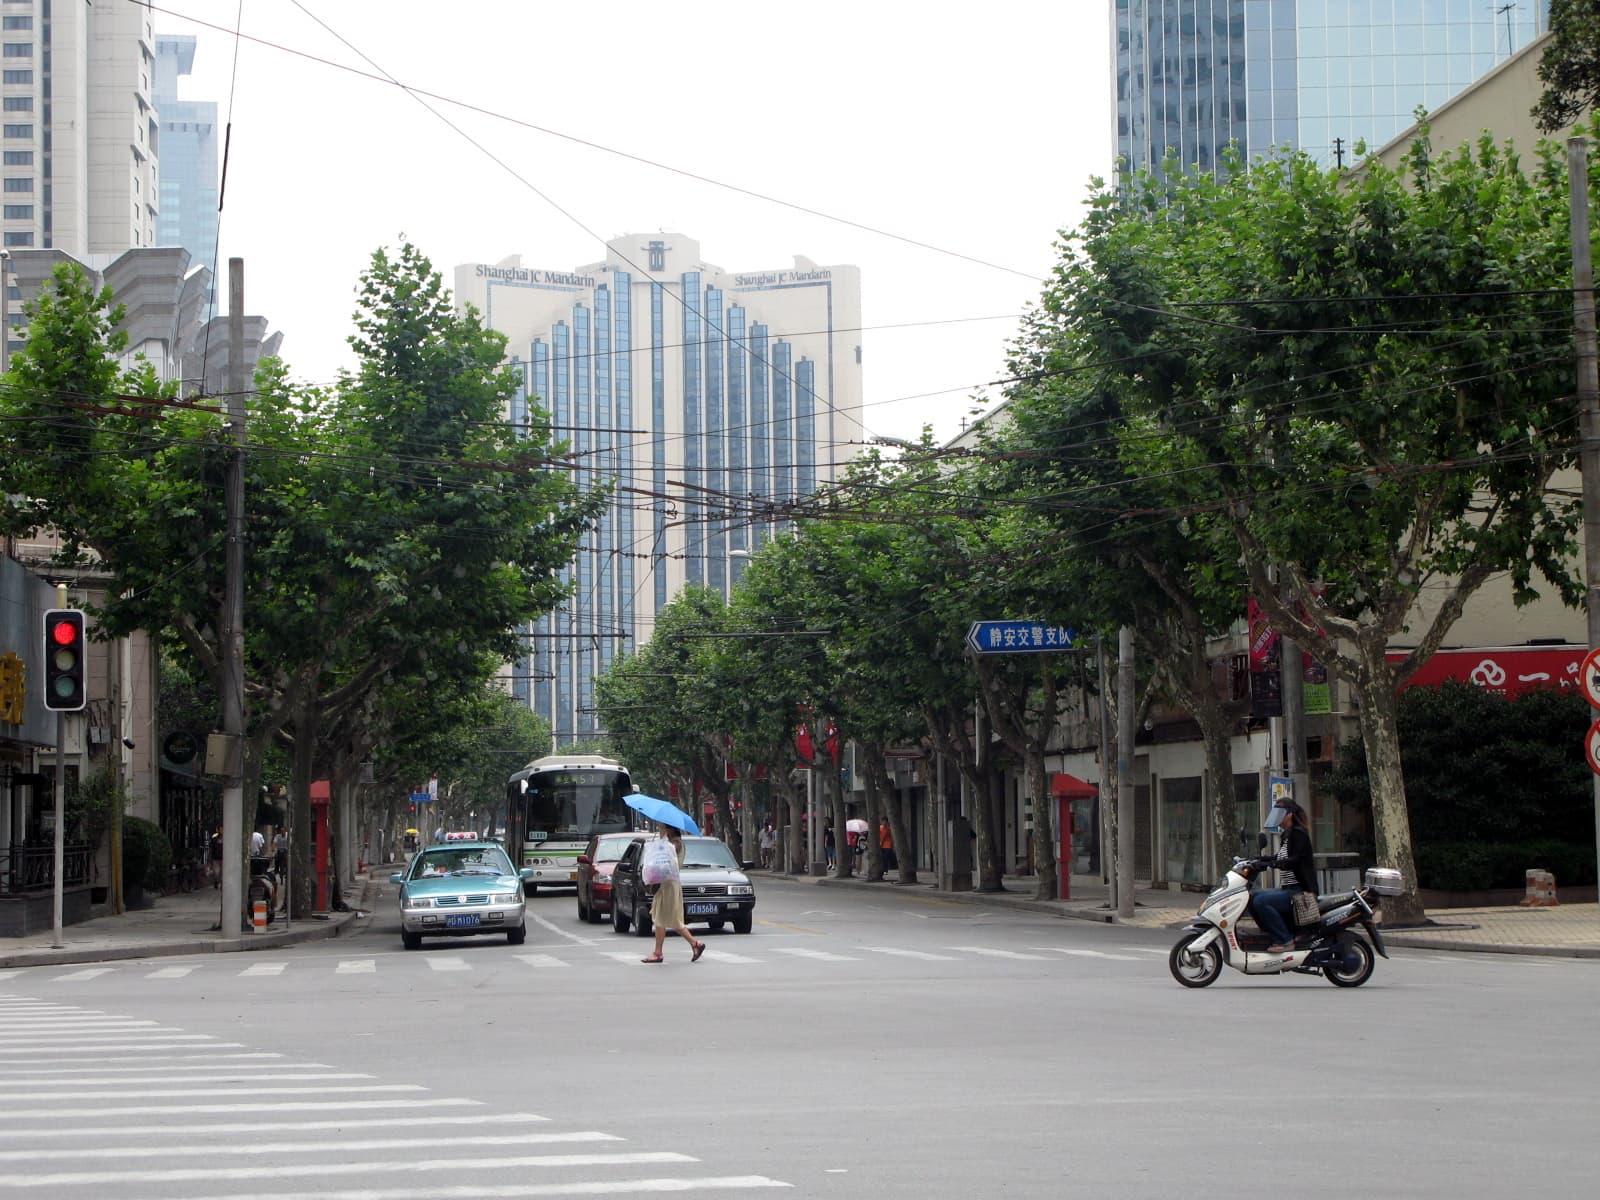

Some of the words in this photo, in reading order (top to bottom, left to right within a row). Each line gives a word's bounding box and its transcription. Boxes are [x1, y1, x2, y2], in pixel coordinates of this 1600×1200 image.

[476, 264, 528, 281] Shanghai
[530, 270, 543, 283] JC
[545, 271, 595, 287] Mandarin
[735, 273, 776, 286] Shanghai
[778, 272, 787, 284] JC
[789, 268, 831, 281] Mandarin
[990, 626, 1072, 647] 静安交警支队
